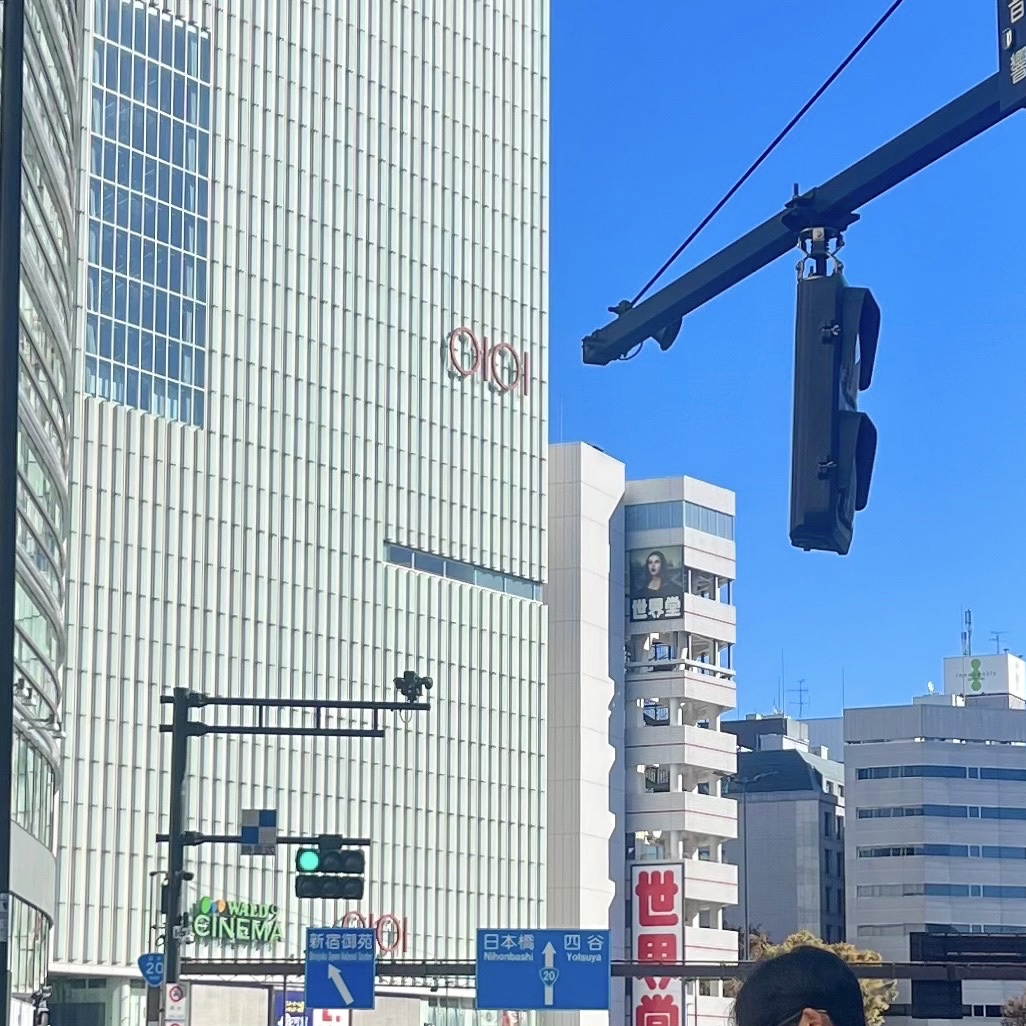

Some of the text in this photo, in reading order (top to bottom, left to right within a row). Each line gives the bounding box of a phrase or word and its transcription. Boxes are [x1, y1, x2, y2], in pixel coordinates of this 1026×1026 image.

[632, 596, 681, 619] 世界堂
[194, 914, 284, 942] CINEMA
[309, 933, 373, 949] 新宿御苑
[484, 933, 534, 950] 日本橋
[564, 934, 604, 951] 四谷
[484, 952, 534, 961] Nihonbashi
[567, 953, 602, 963] Yotsuya
[146, 962, 164, 974] 20
[543, 971, 555, 981] 20
